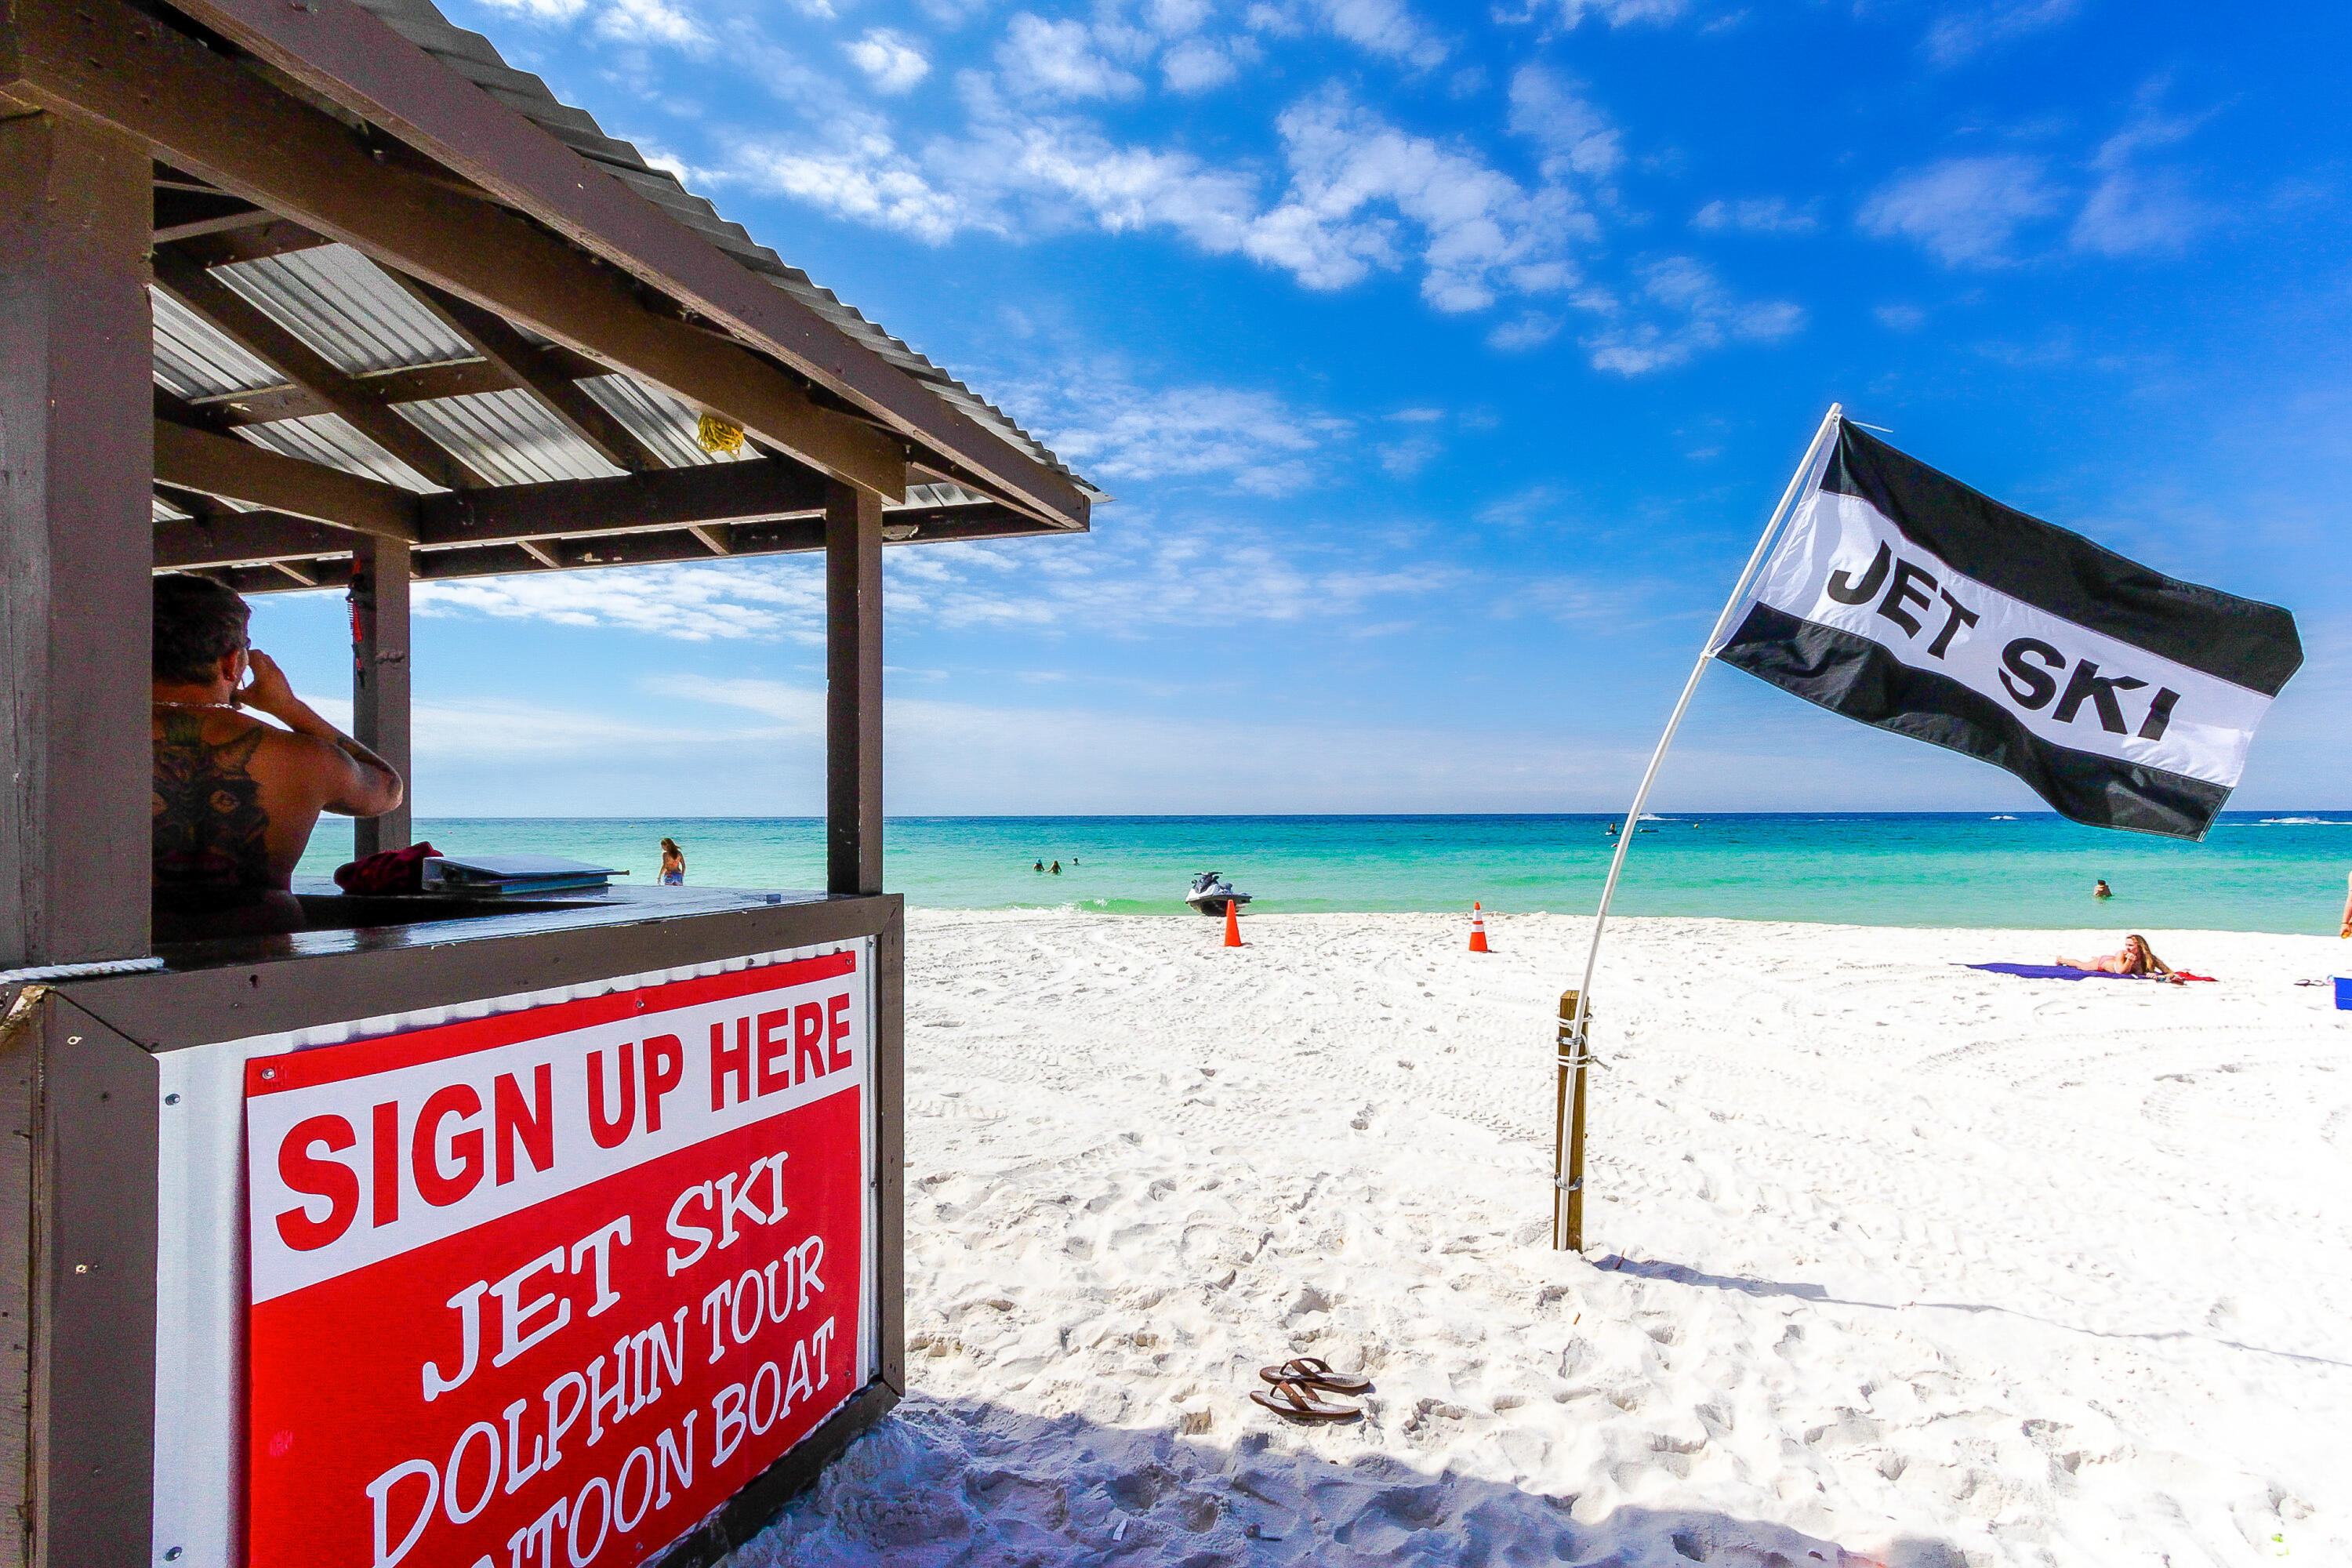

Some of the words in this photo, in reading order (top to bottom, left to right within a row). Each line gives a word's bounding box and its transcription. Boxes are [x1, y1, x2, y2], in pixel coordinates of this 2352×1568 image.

[1828, 539, 1980, 660] JET
[1998, 637, 2181, 742] SKI
[275, 1063, 554, 1252] SIGN
[586, 1033, 684, 1149] UP
[710, 993, 852, 1112] HERE
[365, 1305, 688, 1568] DOLPHIN
[702, 1236, 826, 1364] TOUR
[423, 1215, 632, 1402] JET
[666, 1152, 789, 1277] SKI
[471, 1410, 698, 1568] TOON
[711, 1316, 835, 1468] BOAT
